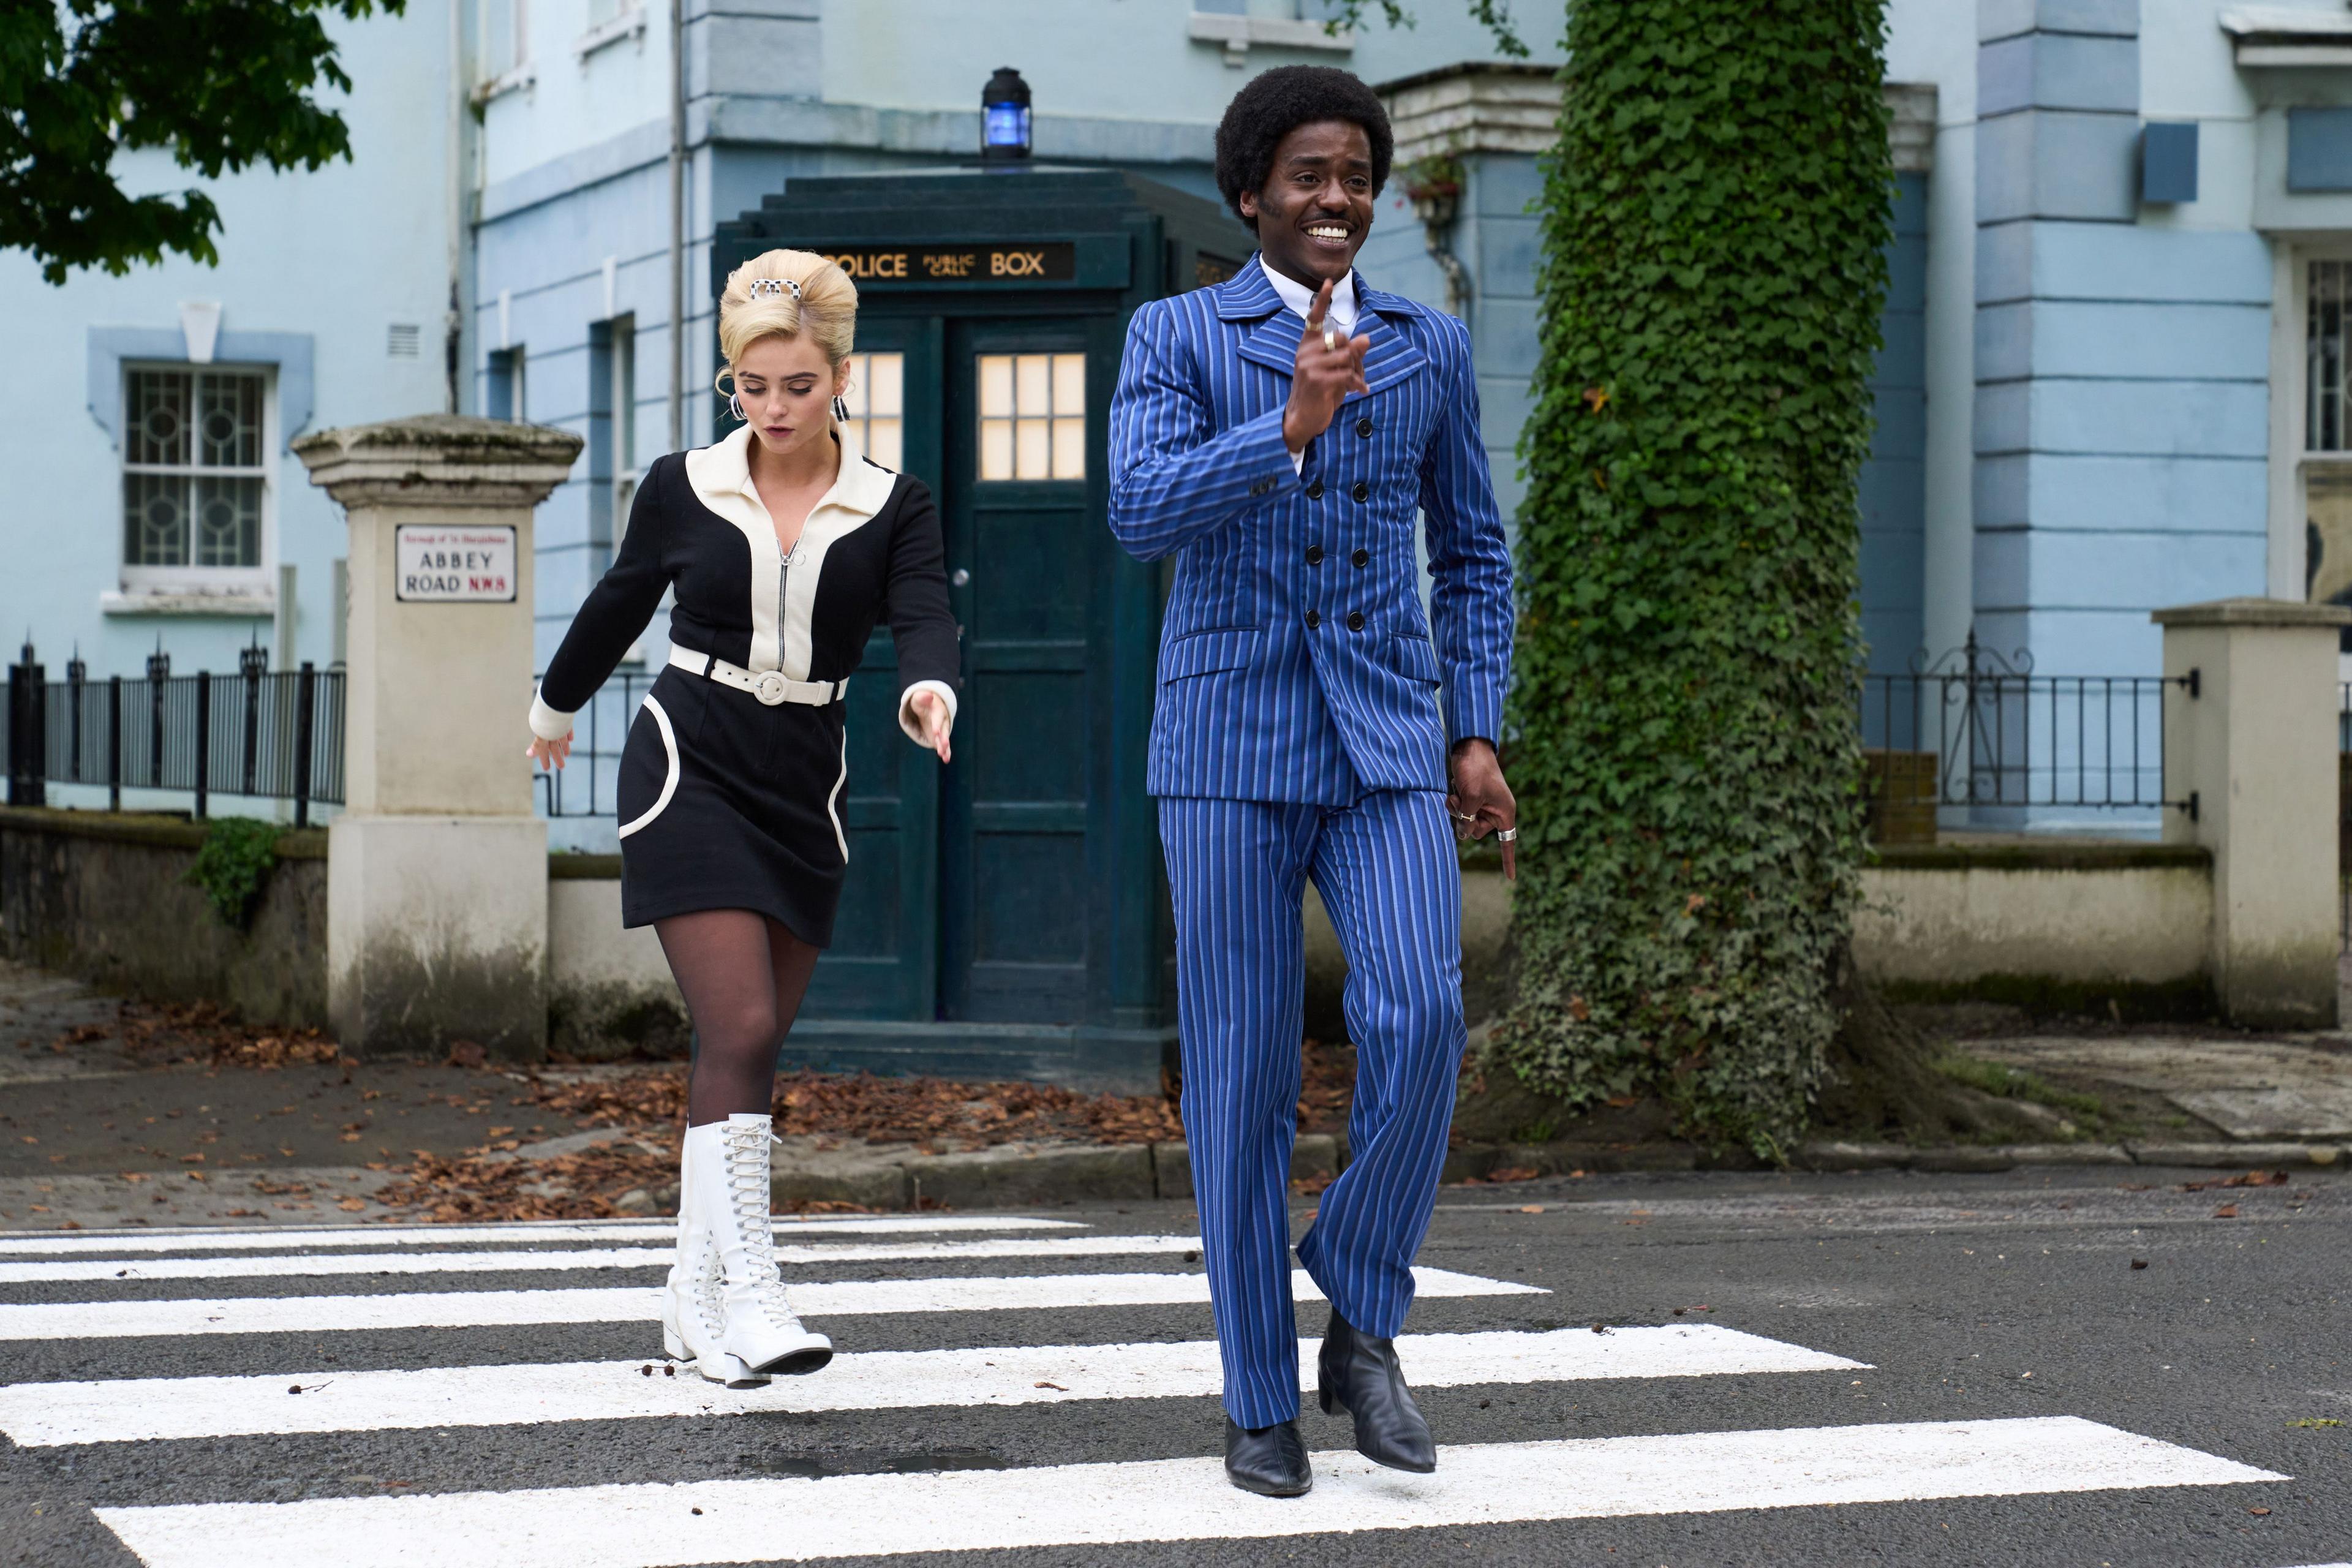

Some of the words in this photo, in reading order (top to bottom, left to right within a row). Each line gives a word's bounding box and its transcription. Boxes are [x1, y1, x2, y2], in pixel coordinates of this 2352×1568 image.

[922, 254, 976, 268] PUBLIC
[990, 252, 1045, 276] BOX
[930, 266, 969, 276] CALL
[420, 552, 493, 570] ABBEY
[405, 576, 460, 592] ROAD
